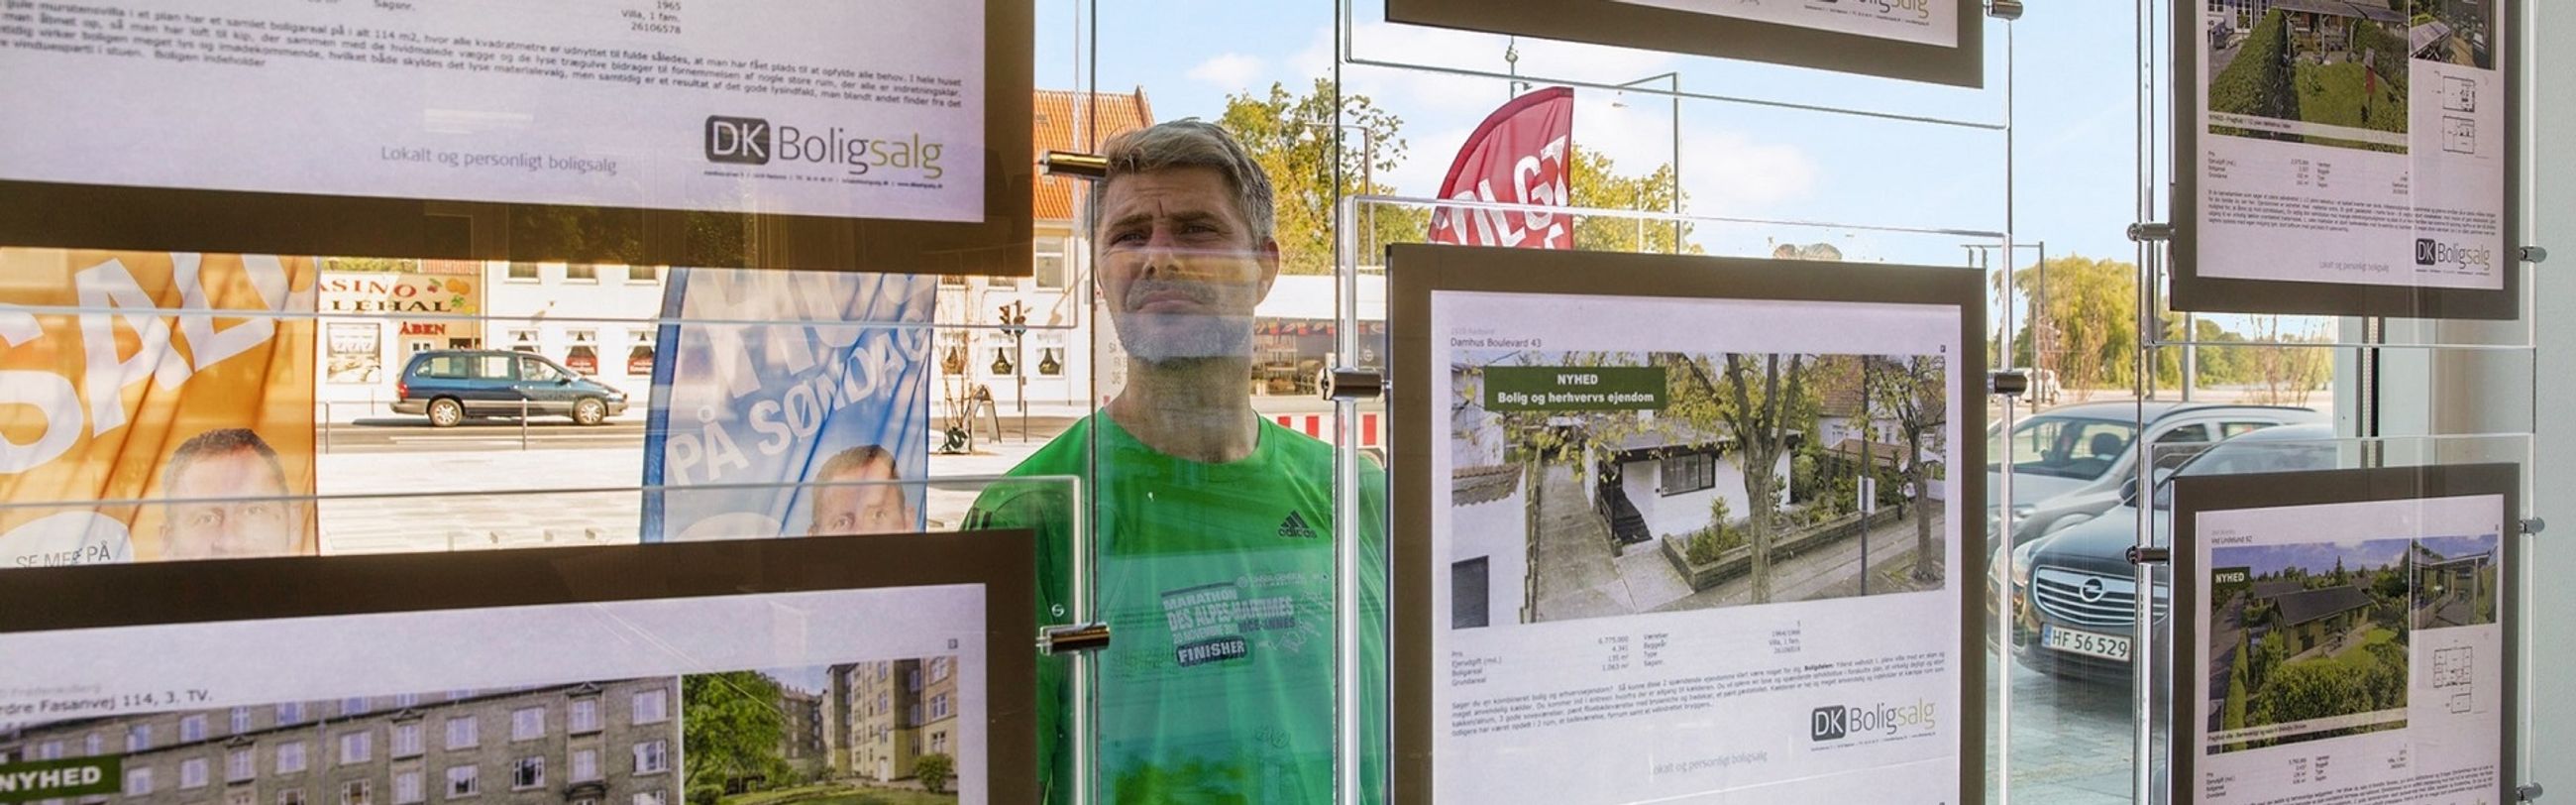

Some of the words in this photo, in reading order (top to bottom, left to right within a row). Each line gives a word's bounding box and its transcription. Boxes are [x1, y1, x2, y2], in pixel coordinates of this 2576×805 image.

[621, 10, 645, 21] Villa,
[657, 1, 681, 12] 1965
[476, 36, 545, 52] kvadratmetre
[565, 44, 606, 58] udnyttet
[610, 48, 620, 58] til
[772, 61, 796, 73] plads
[859, 69, 874, 79] alle
[536, 54, 556, 66] lyse
[611, 59, 652, 74] bidrager
[658, 63, 667, 73] til
[758, 72, 784, 84] nogle
[788, 74, 810, 84] store
[840, 78, 856, 88] der
[860, 80, 876, 90] alle
[598, 71, 641, 85] samtidig
[673, 77, 709, 88] resultat
[726, 80, 740, 90] det
[744, 82, 768, 94] gode
[844, 89, 872, 101] blandt
[381, 146, 431, 163] Lokalt
[438, 153, 459, 168] og
[464, 153, 543, 172] personligt
[549, 156, 616, 176] boligsalg
[713, 121, 765, 158] DK
[779, 126, 943, 180] Boligsalg
[1440, 135, 1568, 248] OLGT
[2417, 241, 2435, 261] DK
[2438, 243, 2490, 271] Boligsalg
[399, 320, 446, 335] ÅBEN
[1450, 337, 1484, 348] Damhus
[1487, 337, 1529, 348] Boulevard
[1531, 338, 1542, 348] 43
[1556, 374, 1599, 386] NYHED
[669, 404, 750, 491] PÅ
[749, 308, 931, 458] SØNDAG
[1498, 392, 1528, 405] Bolig
[1531, 395, 1546, 405] og
[1549, 392, 1605, 403] herhvervs
[1607, 392, 1655, 405] ejendom
[1278, 526, 1318, 538] adidas
[87, 539, 111, 563] PÅ
[2215, 572, 2245, 584] NYHED
[1163, 590, 1237, 608] MARATHON
[1167, 608, 1194, 632] DES
[1178, 640, 1244, 663] FINISHER
[2052, 630, 2071, 647] HF
[2075, 633, 2093, 651] 56
[2096, 637, 2127, 657] 529
[41, 697, 115, 712] Fasanvej
[123, 694, 159, 708] 114,
[166, 692, 179, 704] 3.
[187, 690, 213, 703] TV.
[1814, 707, 1845, 737] DK
[1850, 698, 1936, 736] Boligsalg
[0, 765, 102, 792] NYHED
[1650, 762, 1673, 774] okalt
